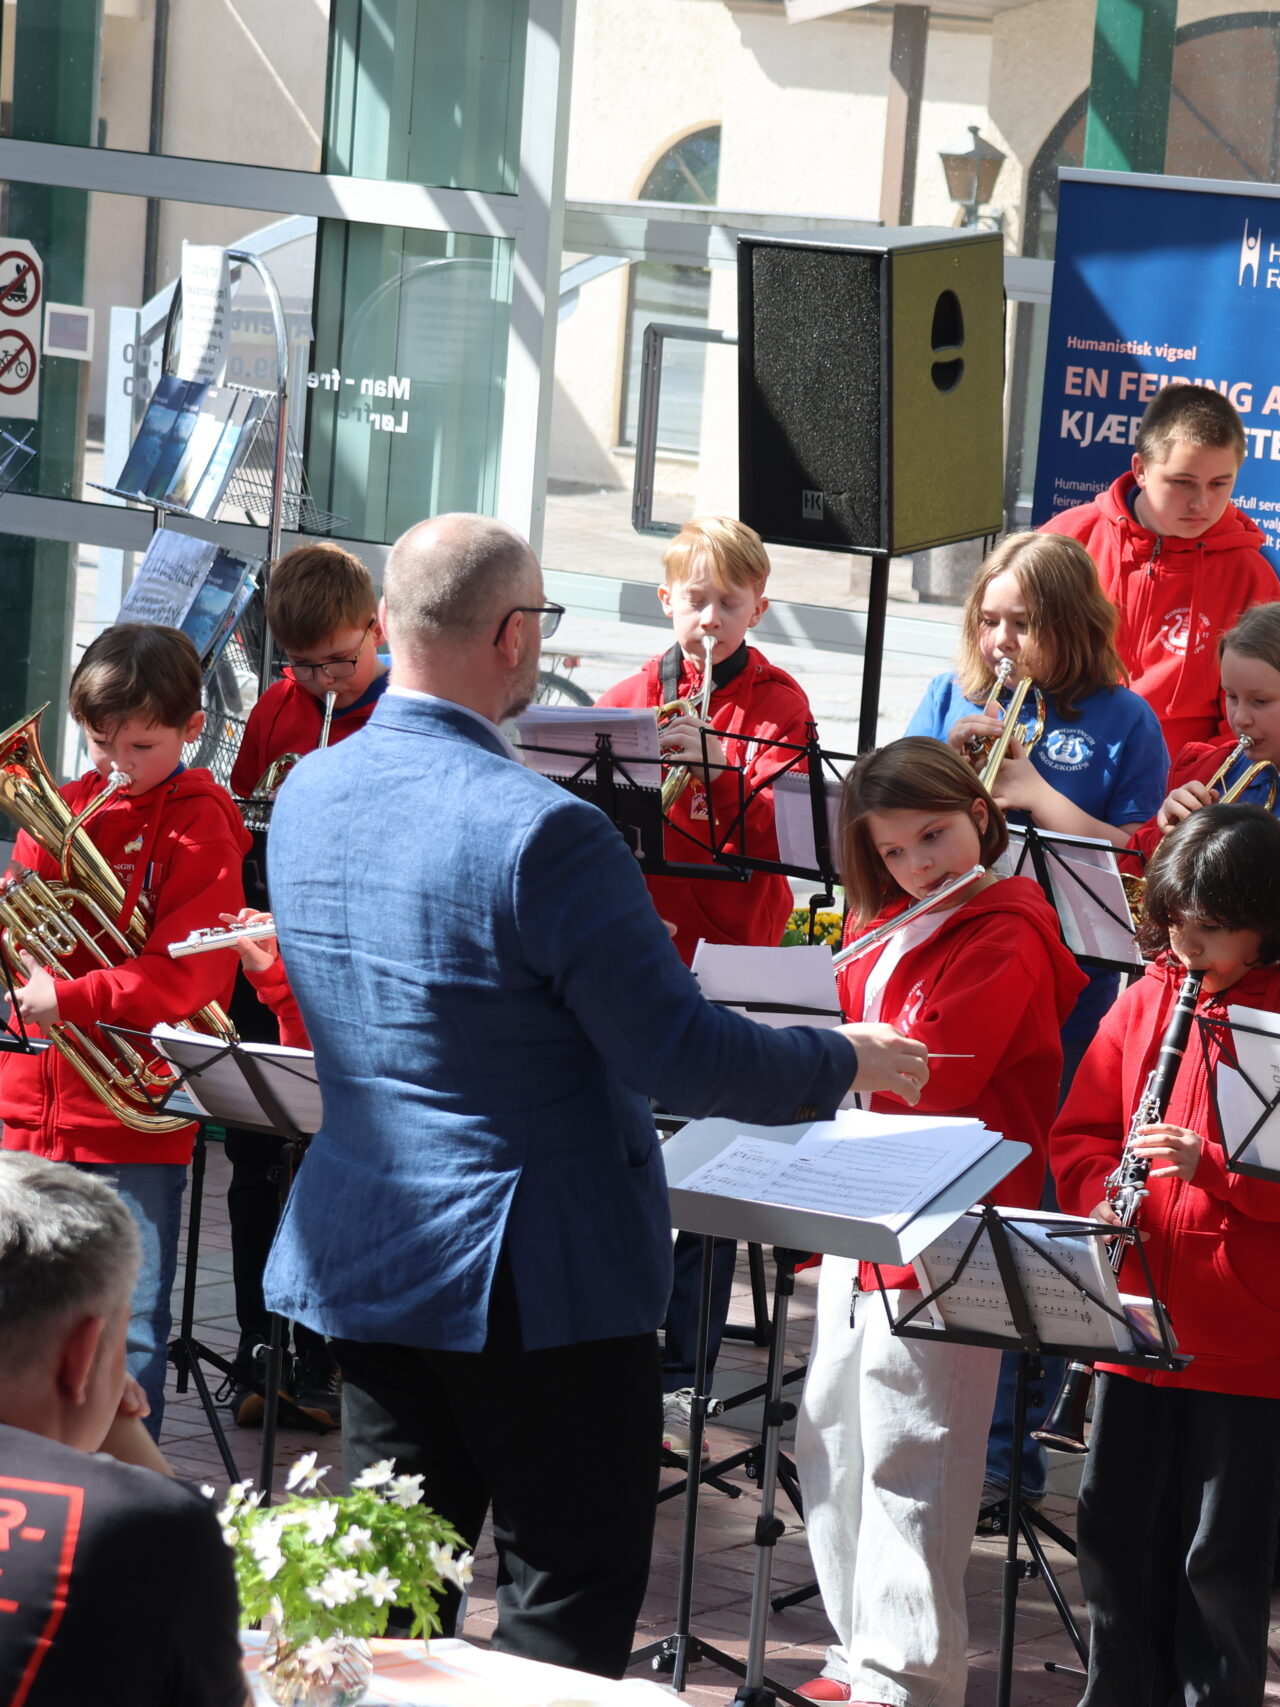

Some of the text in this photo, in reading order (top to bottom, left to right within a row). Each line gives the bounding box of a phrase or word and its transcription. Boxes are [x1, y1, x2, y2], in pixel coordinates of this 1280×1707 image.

[1067, 335, 1197, 362] Humanistisk vigsel
[1064, 365, 1109, 399] EN
